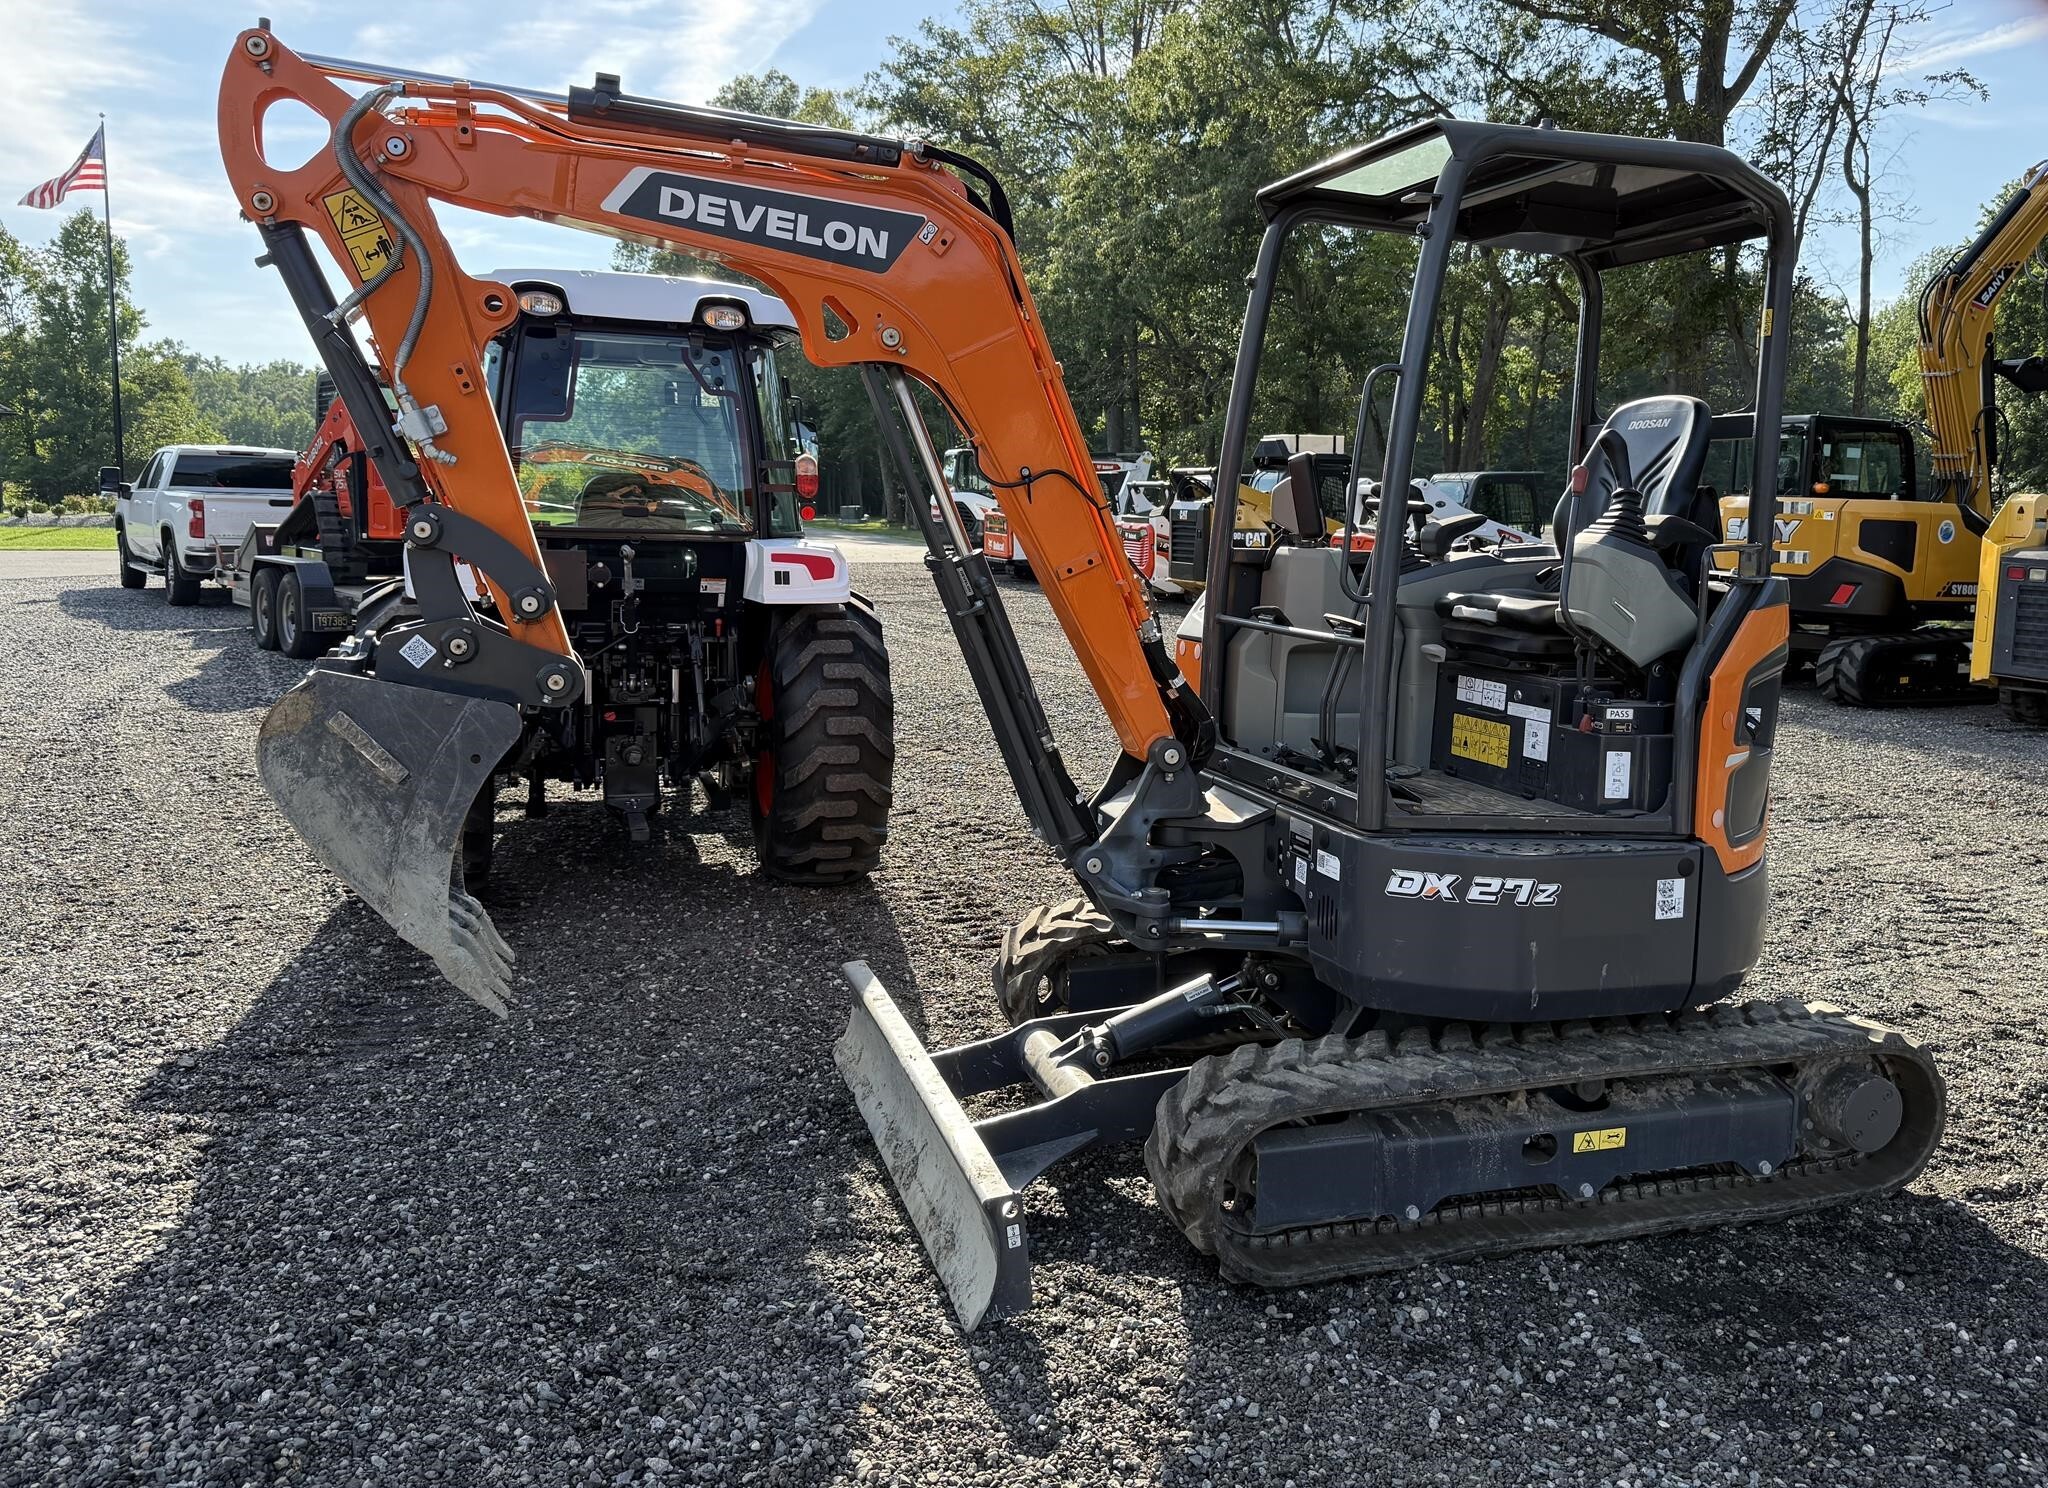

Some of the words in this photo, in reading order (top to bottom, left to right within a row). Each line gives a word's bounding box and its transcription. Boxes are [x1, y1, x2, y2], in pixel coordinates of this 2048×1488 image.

[658, 185, 889, 259] DEVELON
[1981, 269, 2007, 304] SANY
[1628, 418, 1671, 430] DOOSAN
[1245, 532, 1267, 547] CAT
[1726, 516, 1802, 544] SY
[1609, 710, 1630, 718] PASS
[1385, 868, 1462, 903] DX
